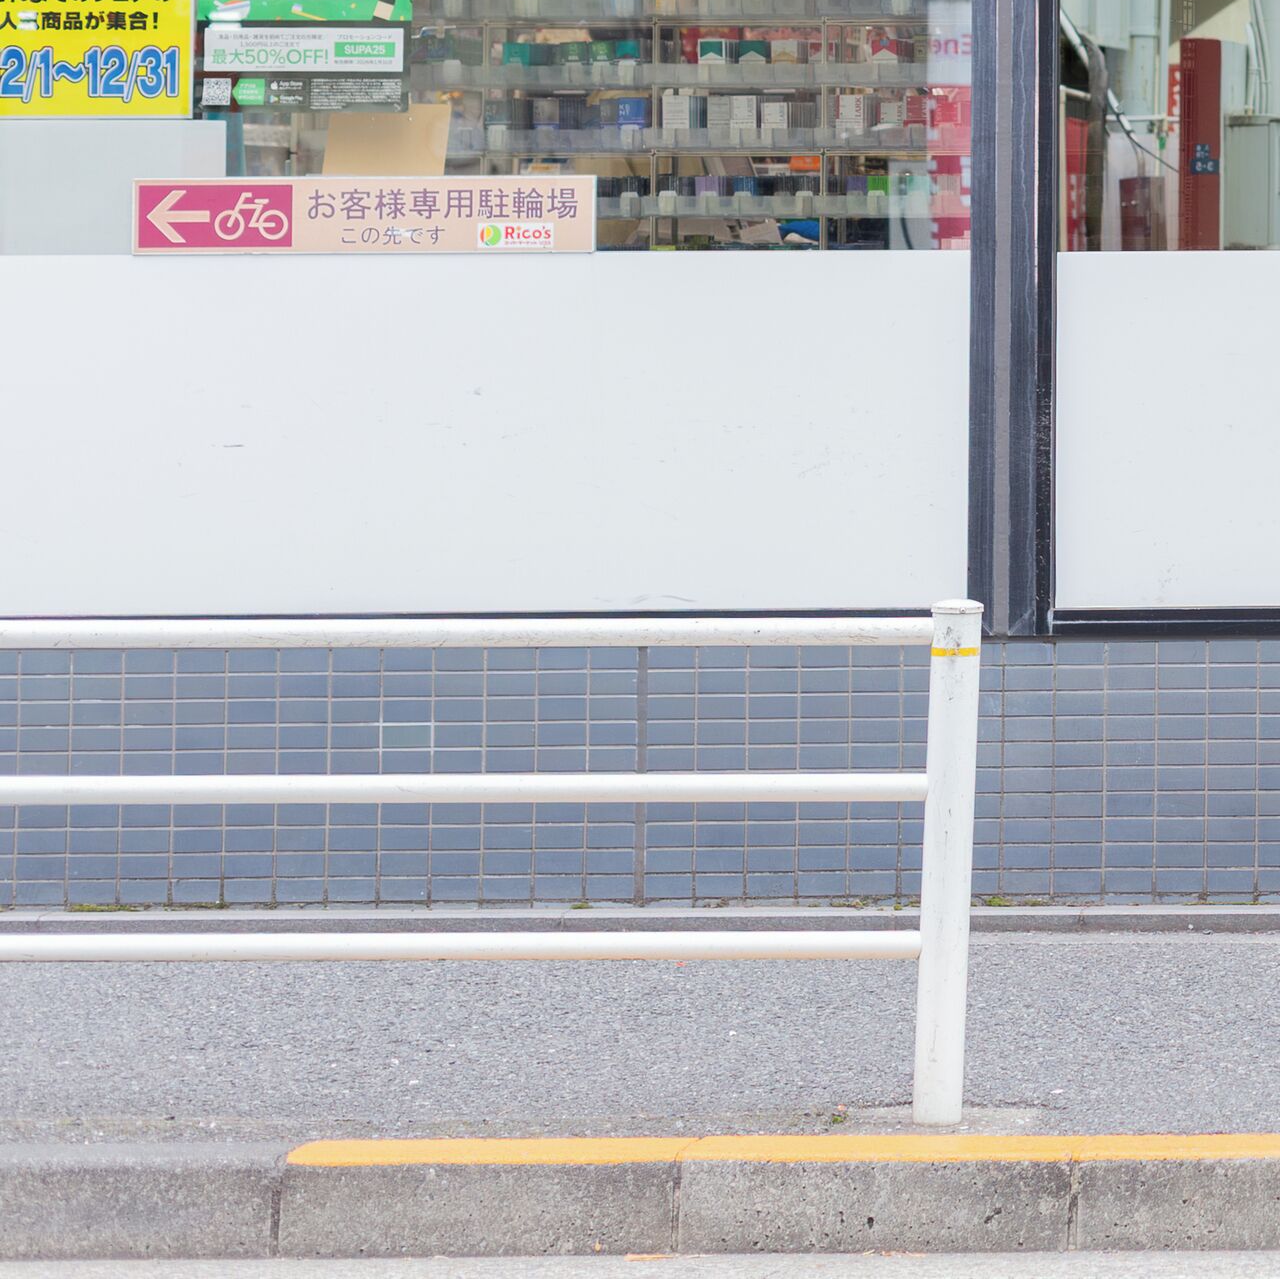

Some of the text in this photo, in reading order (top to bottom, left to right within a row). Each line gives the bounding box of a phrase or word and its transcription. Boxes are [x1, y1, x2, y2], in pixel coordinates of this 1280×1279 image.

[0, 11, 159, 31] 人商品が集合!
[212, 48, 329, 65] 最大50%OFF!
[307, 188, 578, 220] お客様専用駐輪場
[341, 226, 446, 245] この先です
[505, 225, 551, 239] Rico's
